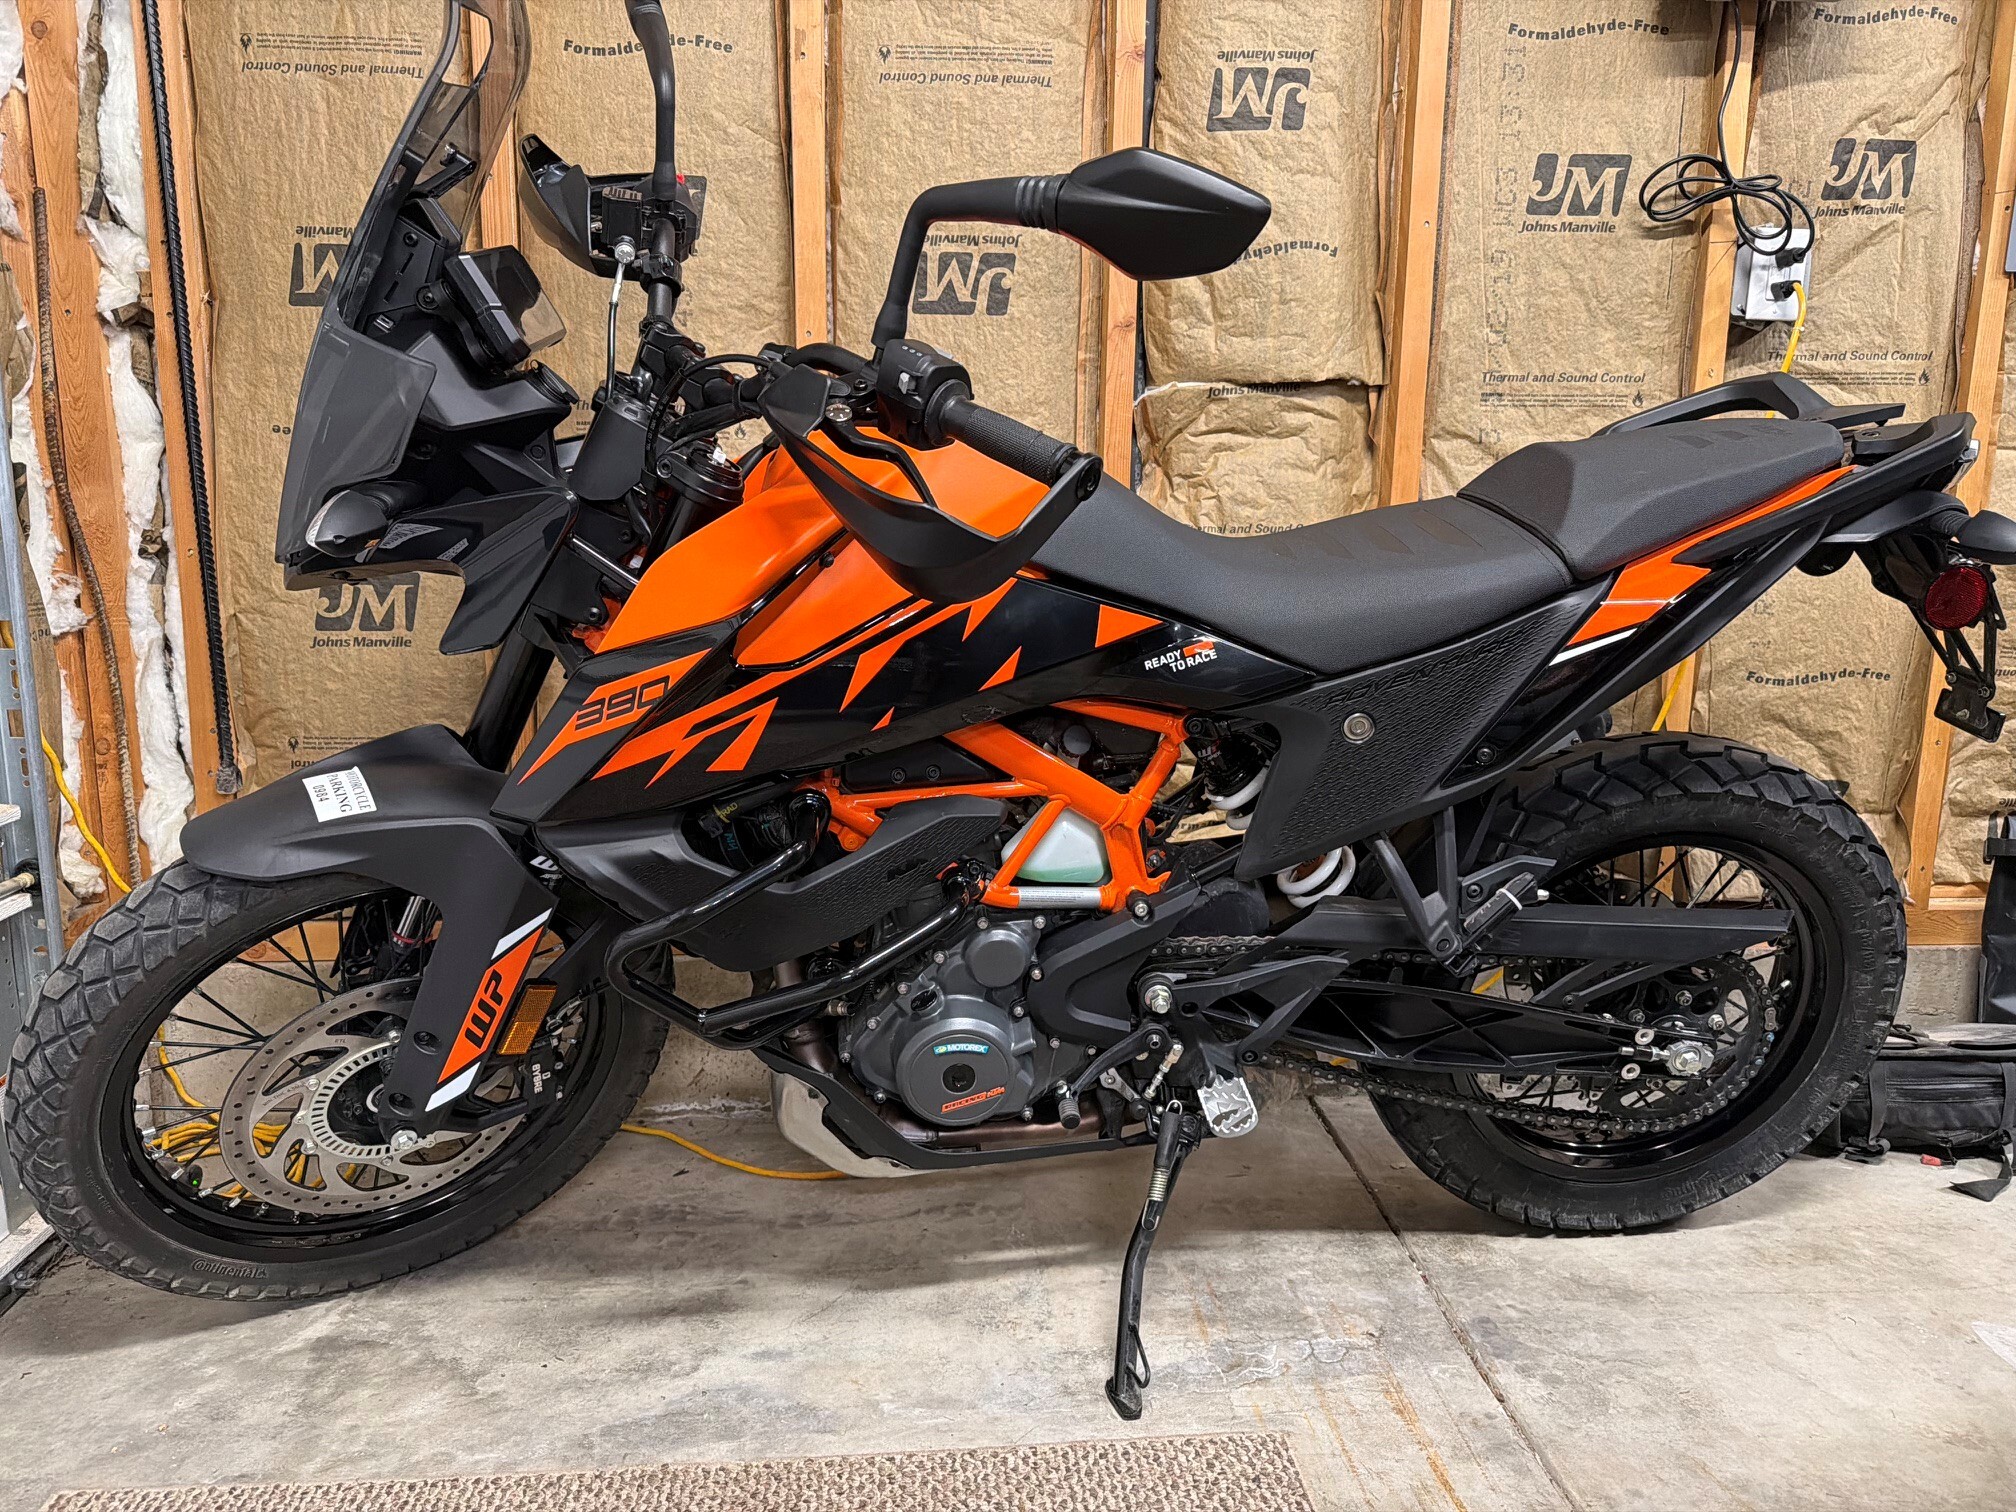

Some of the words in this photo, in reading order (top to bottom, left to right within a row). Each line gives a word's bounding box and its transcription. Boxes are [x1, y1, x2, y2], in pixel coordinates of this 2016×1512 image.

[1814, 5, 1958, 25] Formaldehyde-Free
[1508, 18, 1670, 41] Formaldehyde-Free
[563, 34, 733, 56] Formaldede-Free
[1217, 50, 1275, 62] Manville
[1277, 49, 1318, 62] Johns
[242, 61, 291, 73] Control
[295, 62, 337, 74] Sound
[340, 63, 364, 74] and
[369, 64, 424, 79] Thermal
[878, 72, 926, 84] Control
[930, 73, 971, 85] Sound
[974, 74, 998, 85] and
[1001, 75, 1052, 88] Thermal
[1206, 67, 1311, 132] JM
[1821, 137, 1917, 200] JM
[1525, 152, 1633, 217] JM
[1812, 206, 1849, 219] Johns
[1851, 203, 1906, 217] Manville
[1518, 221, 1557, 234] Johns
[1559, 221, 1616, 233] Manville
[924, 235, 980, 247] Manville
[982, 234, 1022, 248] Johns
[289, 242, 349, 307] M
[912, 251, 1016, 316] JM
[1822, 351, 1847, 361] and
[1849, 351, 1889, 361] Sound
[1891, 350, 1933, 361] Control
[1481, 372, 1530, 383] Thermal
[1532, 373, 1556, 382] and
[1557, 372, 1597, 383] Sound
[1601, 372, 1646, 383] Control
[1206, 385, 1245, 399] Johns
[1229, 523, 1252, 534] and
[315, 572, 421, 632] JM
[310, 636, 351, 649] Johns
[353, 636, 412, 647] Manville
[1144, 649, 1182, 671] READY
[1169, 659, 1186, 673] TO
[1185, 649, 1218, 668] RACE
[1746, 667, 1891, 687] Formaldehyde-Free
[575, 675, 670, 731] 390
[312, 784, 330, 802] 0984
[326, 774, 353, 813] PARKING
[529, 855, 559, 871] W
[464, 969, 504, 1050] WP
[946, 1043, 987, 1052] MOTOREX
[532, 1063, 543, 1094] BYBRE
[191, 1258, 258, 1279] Continental
